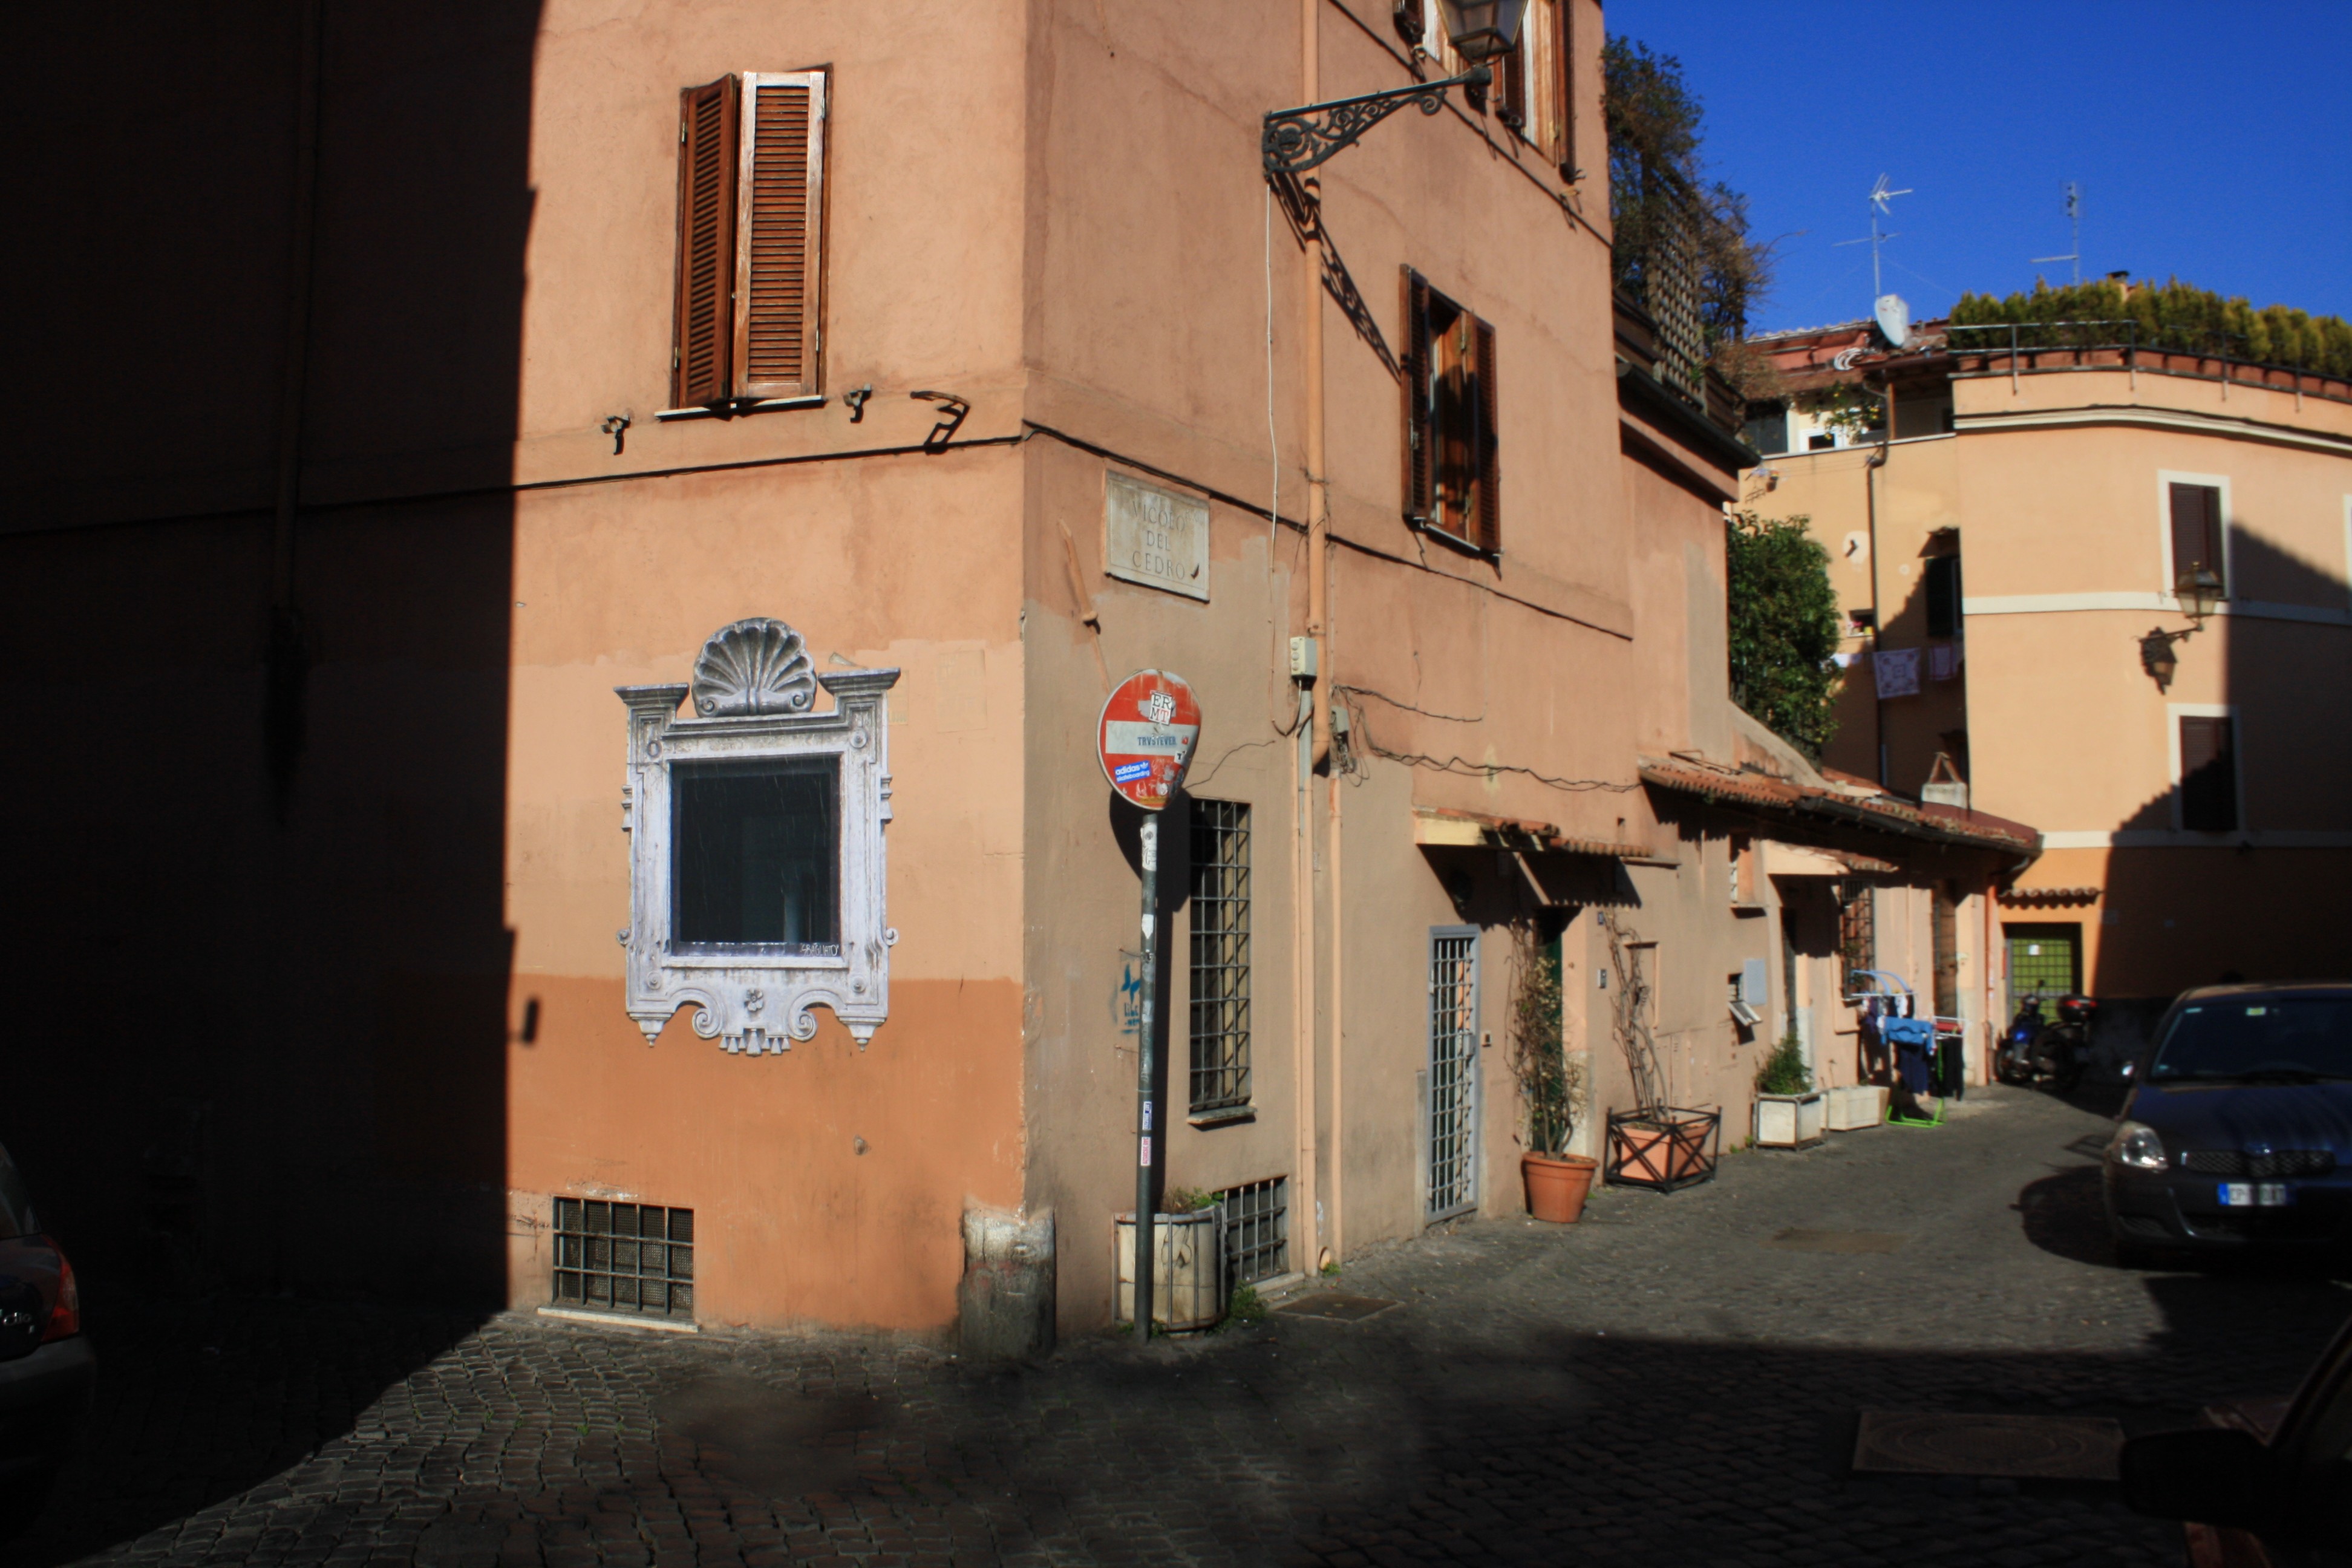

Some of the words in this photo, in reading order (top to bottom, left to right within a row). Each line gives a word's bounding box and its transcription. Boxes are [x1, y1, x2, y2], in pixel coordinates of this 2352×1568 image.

[1132, 501, 1186, 533] VICOLO
[1147, 531, 1171, 552] DEL
[1132, 551, 1186, 580] CEDRO
[1152, 694, 1172, 710] ER
[1150, 707, 1169, 722] MT
[1116, 765, 1140, 775] adidas
